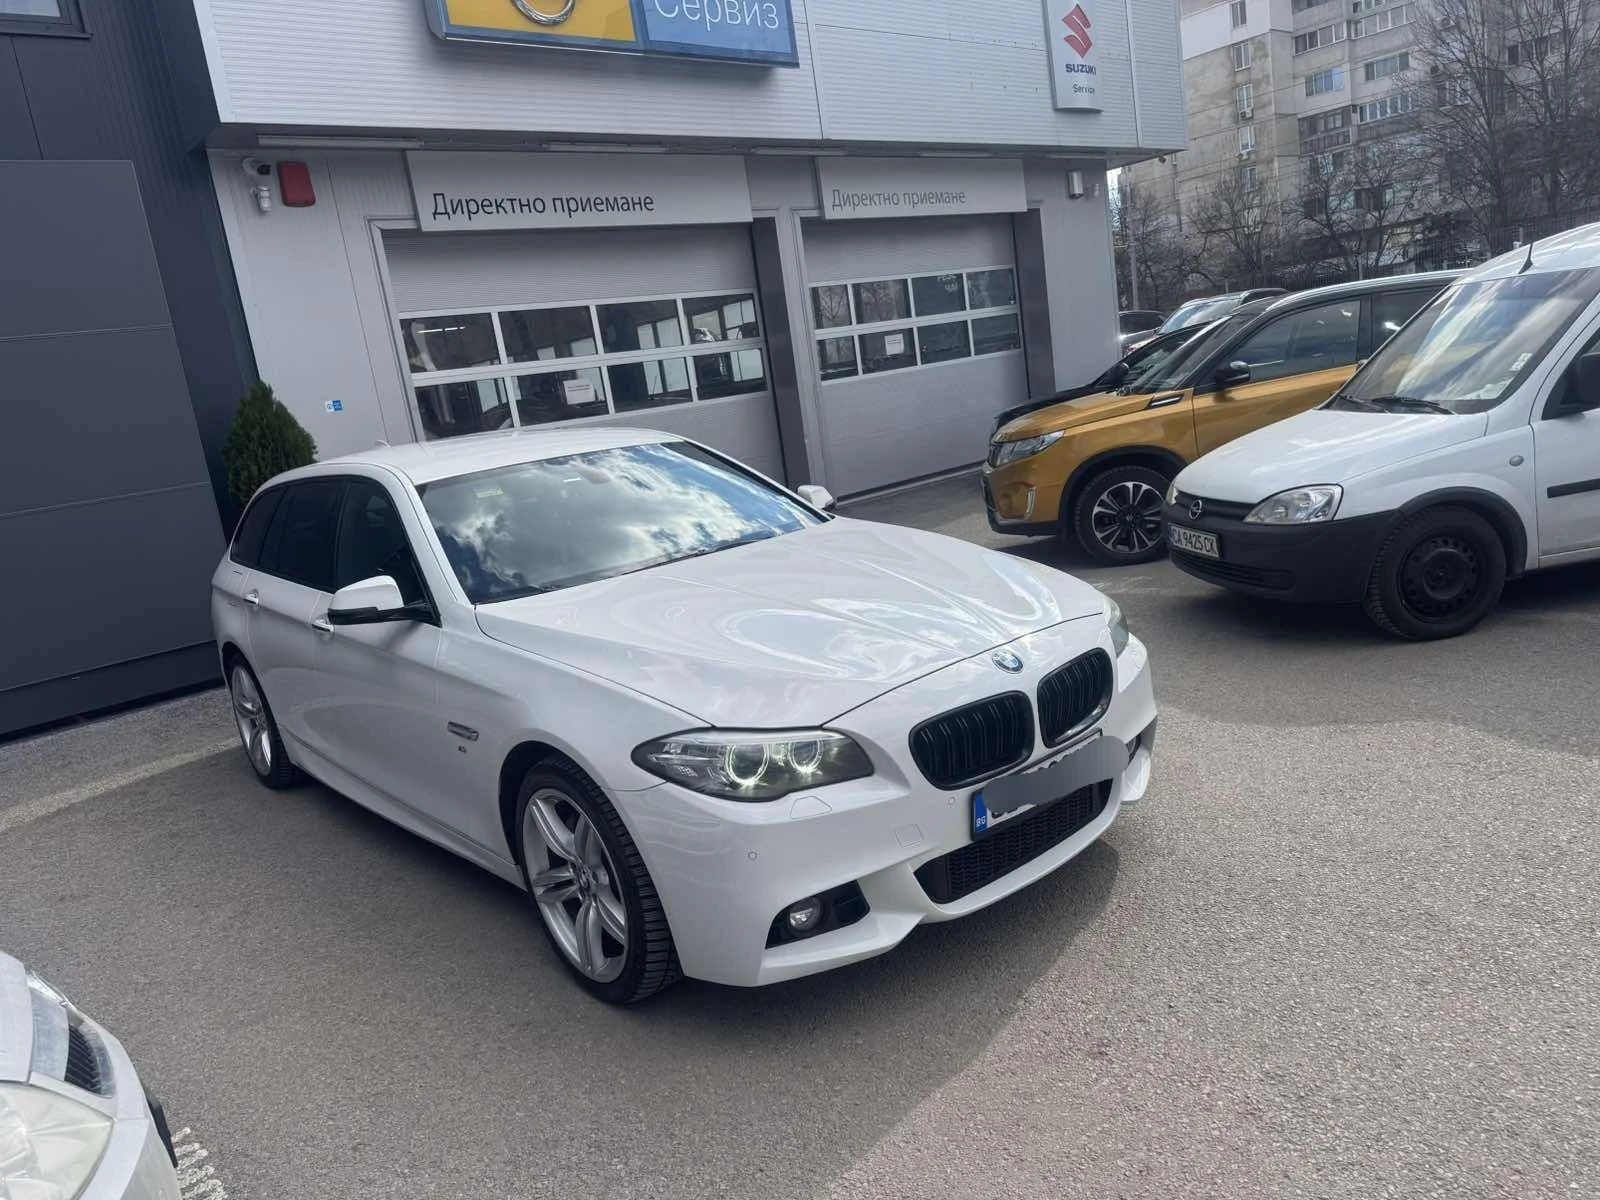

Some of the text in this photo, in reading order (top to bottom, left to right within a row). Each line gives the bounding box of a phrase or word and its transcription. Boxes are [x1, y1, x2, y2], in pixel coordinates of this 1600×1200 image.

[1065, 63, 1097, 75] SUZUKI
[431, 192, 655, 221] Директно приемане
[831, 188, 967, 212] Директно приемане
